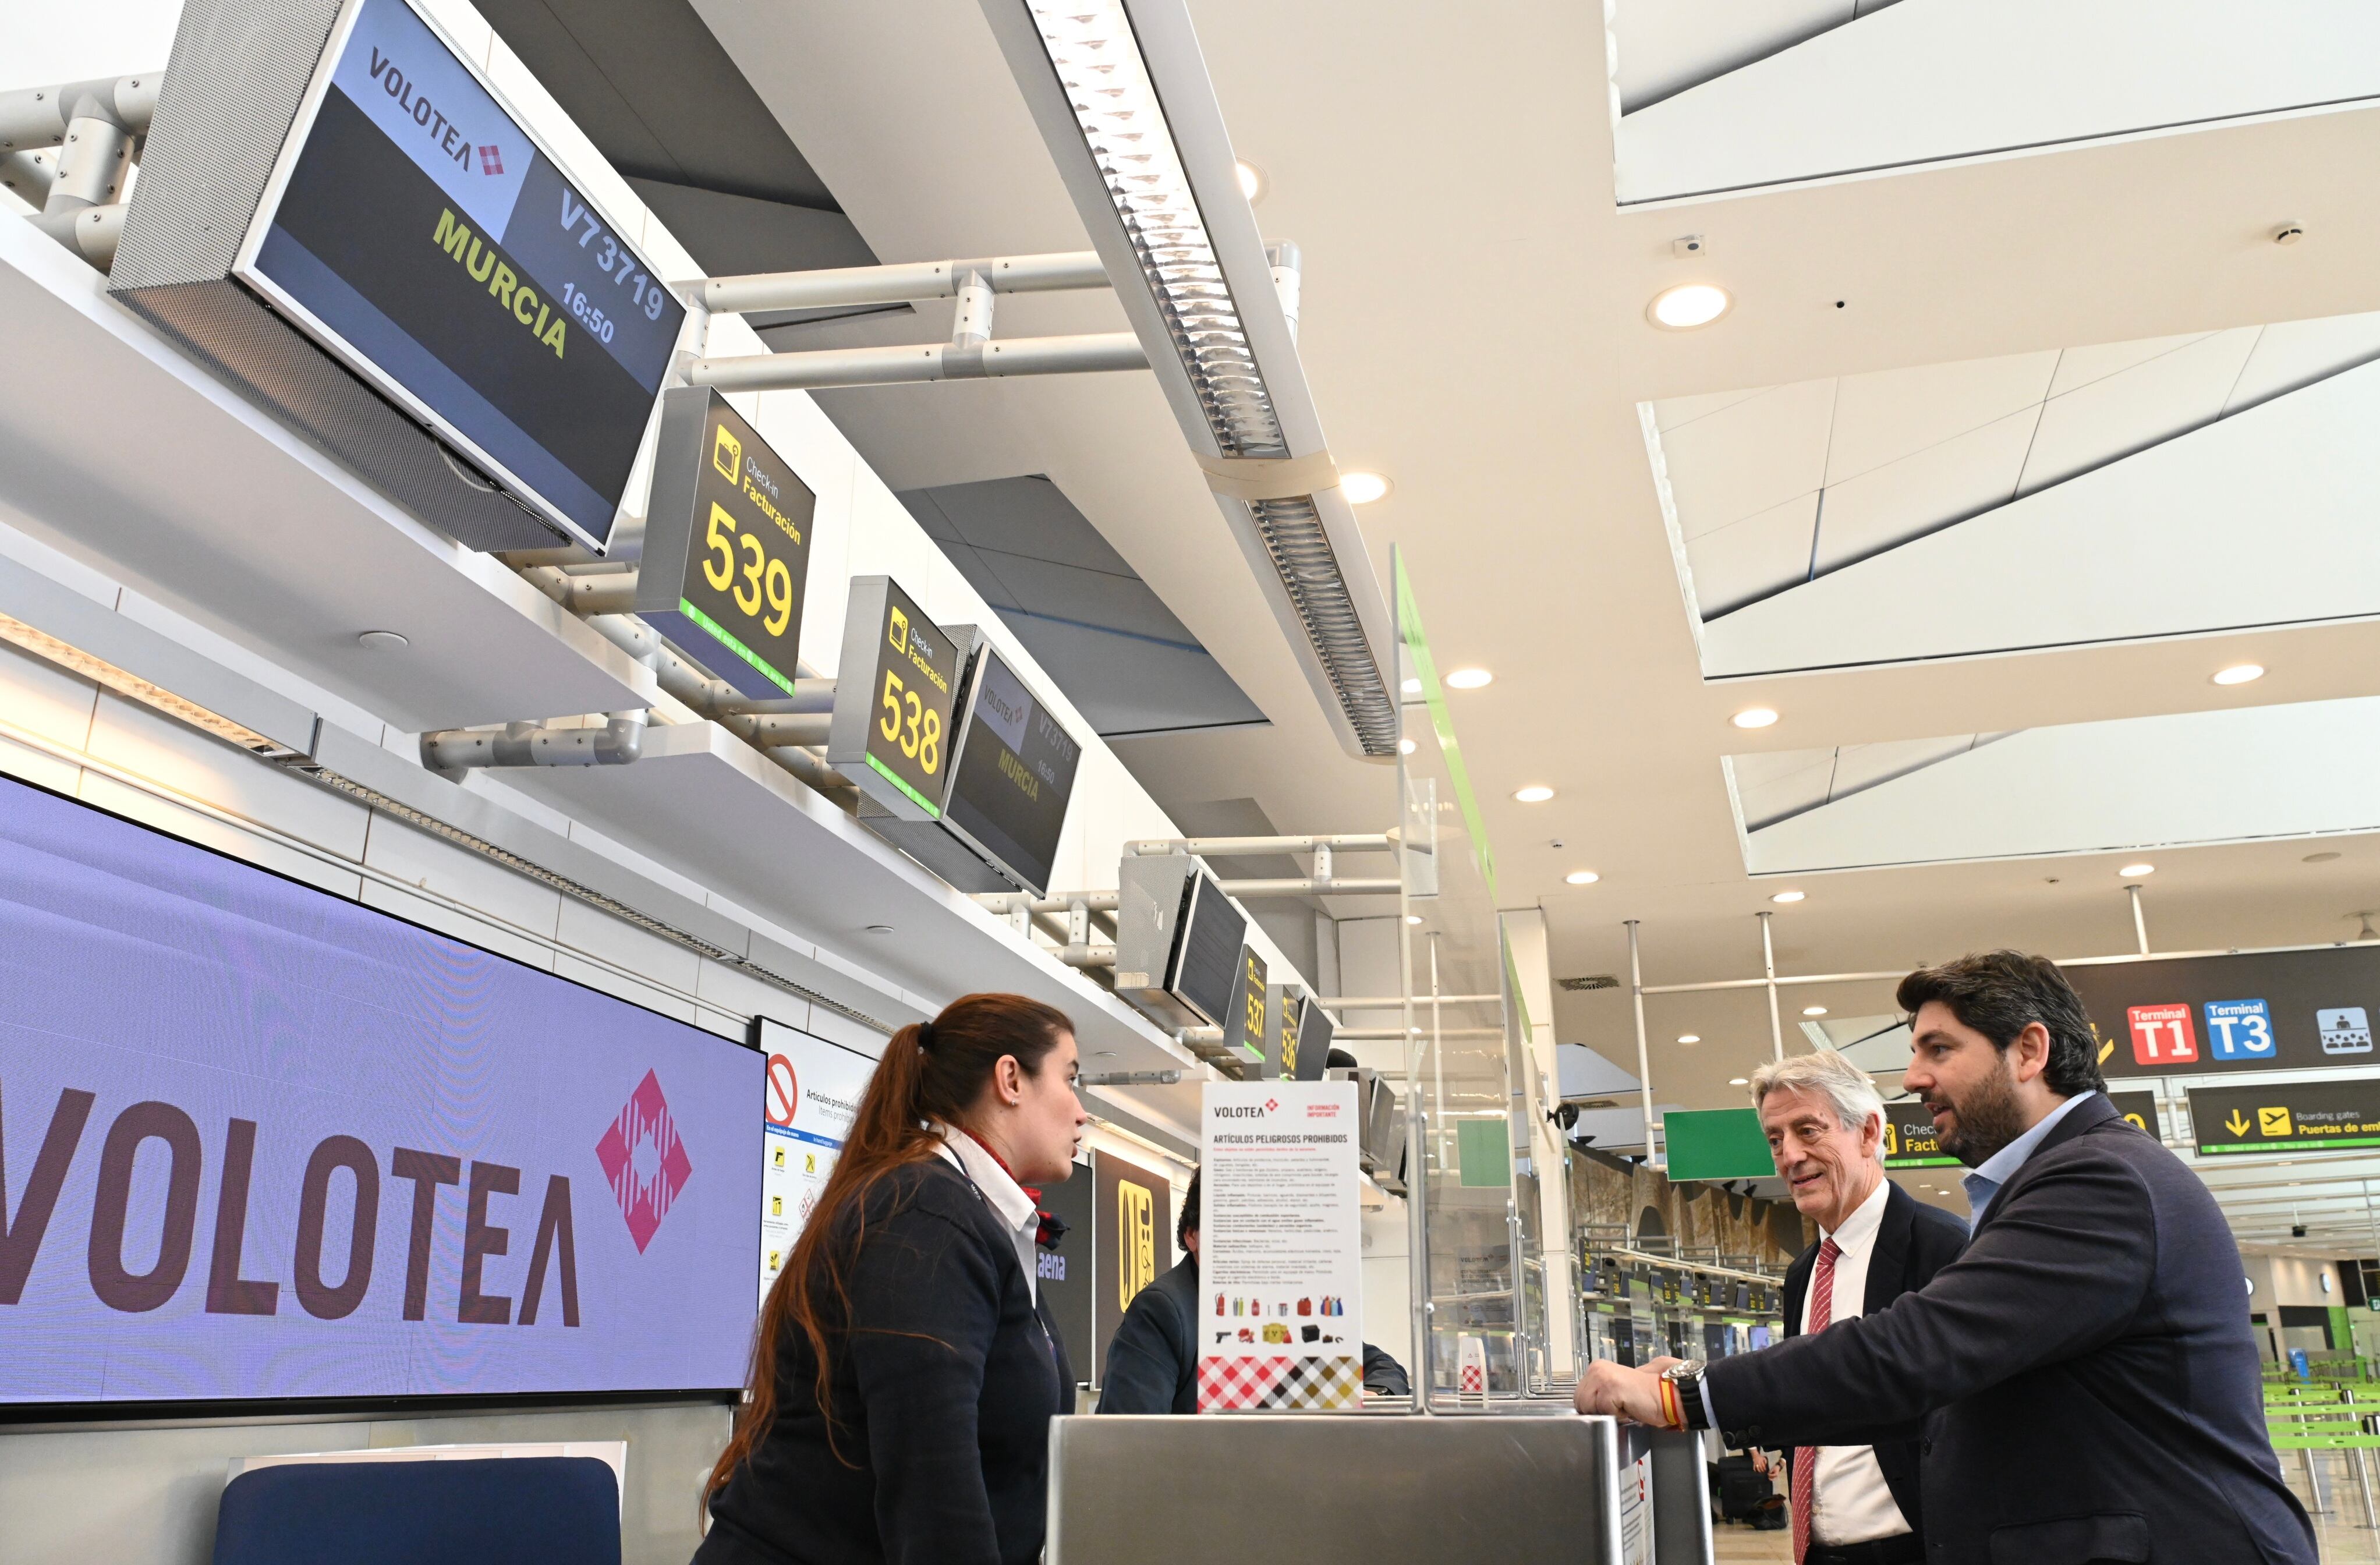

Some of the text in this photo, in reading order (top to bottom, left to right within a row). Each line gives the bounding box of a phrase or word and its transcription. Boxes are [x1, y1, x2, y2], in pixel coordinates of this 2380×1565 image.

[370, 46, 472, 172] VOLOTEA
[559, 187, 664, 321] V73719
[433, 208, 565, 359] MURCIA
[563, 282, 614, 344] 16:50
[746, 456, 778, 499] Check-in
[743, 475, 801, 545] Facturación
[703, 501, 792, 637] 539
[911, 628, 932, 659] Check-in
[909, 645, 947, 694] Facturación
[880, 669, 941, 774] 538
[984, 685, 1013, 726] VOLOTEA
[998, 748, 1039, 802] MURCIA
[1038, 759, 1055, 784] 16:50
[1248, 993, 1264, 1038] 537
[2132, 1008, 2187, 1021] Terminal
[2209, 1003, 2264, 1017] Terminal
[1282, 1028, 1295, 1071] 536
[2135, 1020, 2193, 1057] T1
[2210, 1015, 2271, 1053] T3
[819, 1104, 833, 1118] Items
[1214, 1107, 1264, 1118] VOLOTEA
[1904, 1124, 1937, 1135] Chec
[2296, 1111, 2360, 1121] Boarding gates
[2298, 1124, 2342, 1135] Puertas
[2344, 1123, 2358, 1132] de
[1213, 1133, 1348, 1143] ARTÍCULOS PELIGROSOS PROHIBIDOS
[0, 1087, 580, 1327] VOLOTEA
[971, 1184, 982, 1201] WFS
[1037, 1252, 1065, 1281] aena
